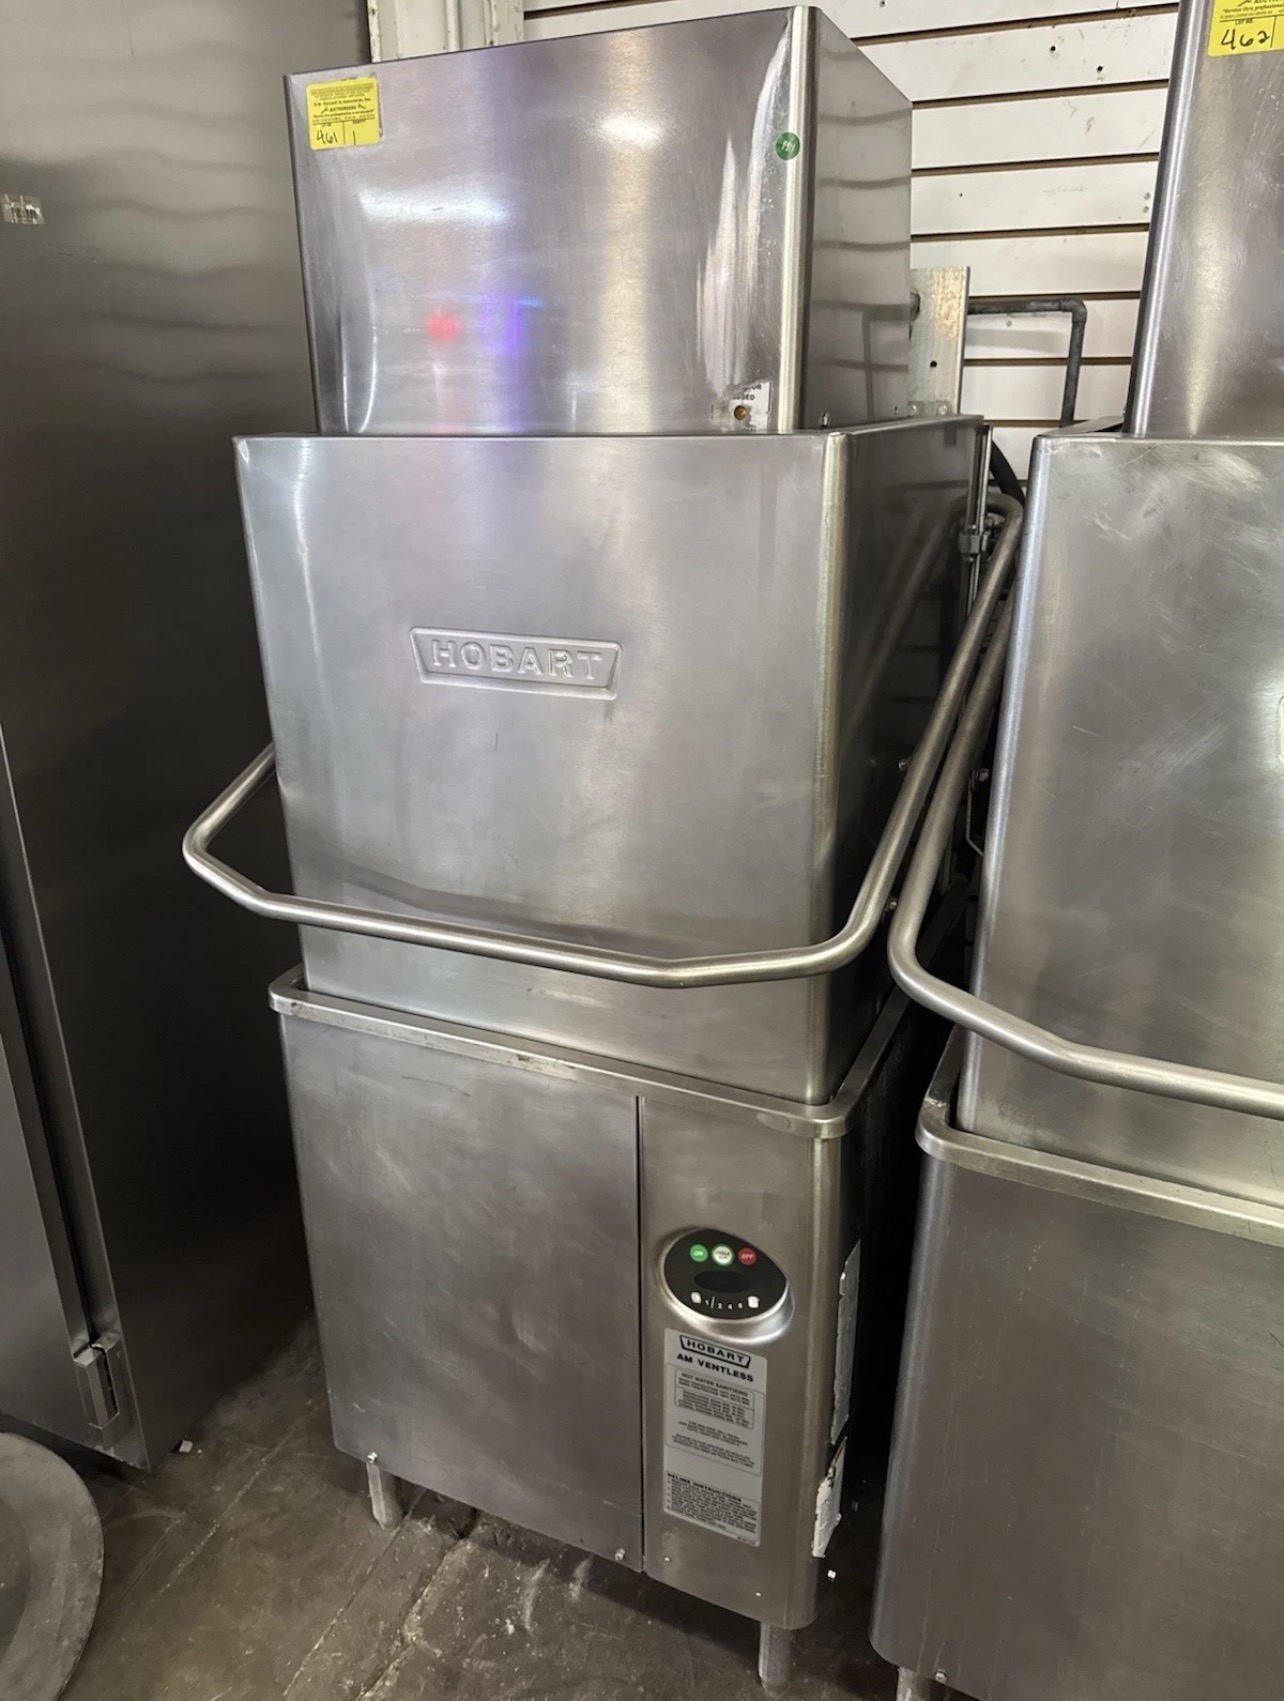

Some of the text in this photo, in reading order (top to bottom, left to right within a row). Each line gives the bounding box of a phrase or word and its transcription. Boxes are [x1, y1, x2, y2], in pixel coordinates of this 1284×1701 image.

[1221, 28, 1270, 50] 462
[316, 129, 338, 145] 461
[431, 638, 603, 680] HOBART
[693, 1249, 704, 1257] ON
[741, 1252, 754, 1260] OFF
[686, 1340, 745, 1362] HOBART
[677, 1353, 754, 1382] AM VENTLESS
